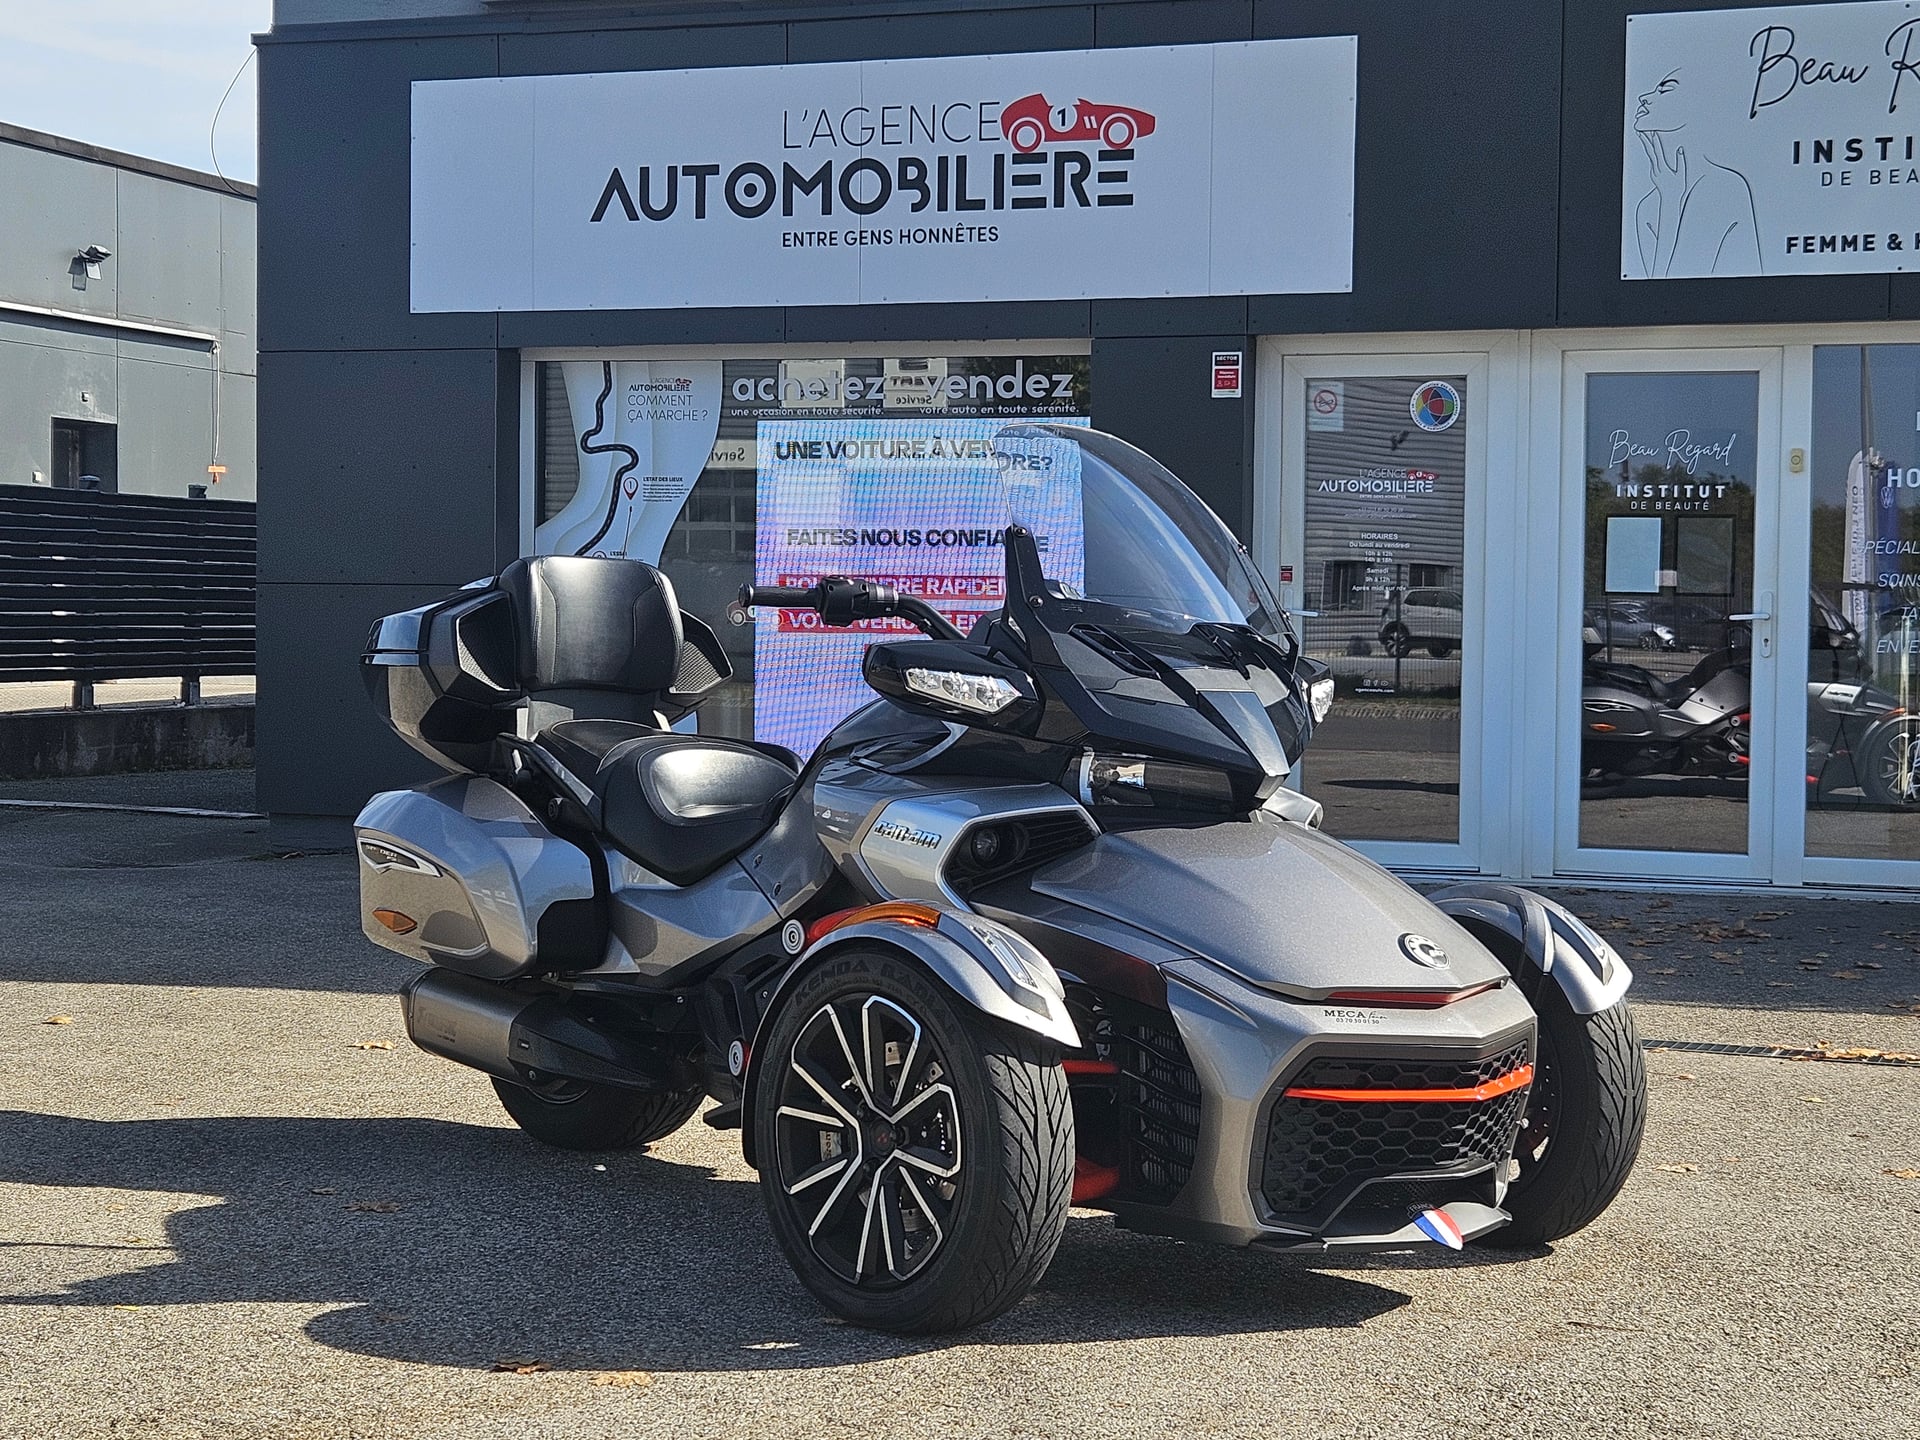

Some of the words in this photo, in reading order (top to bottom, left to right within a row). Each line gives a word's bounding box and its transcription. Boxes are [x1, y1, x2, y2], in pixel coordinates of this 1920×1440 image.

[1749, 25, 1869, 119] Beau
[783, 101, 1000, 149] L'AGENCE
[1792, 136, 1913, 164] INSTI
[1821, 171, 1852, 187] DE
[782, 230, 838, 248] ENTRE
[843, 229, 893, 247] GENS
[899, 222, 999, 245] HONNÊTES
[1786, 233, 1876, 253] FEMME
[1886, 233, 1903, 250] &
[732, 362, 886, 401] achetez
[921, 359, 1074, 399] vendez
[627, 394, 694, 406] COMMENT
[920, 405, 948, 414] votre
[952, 405, 977, 414] auto
[980, 406, 994, 414] en
[998, 404, 1028, 414] toute
[1031, 402, 1080, 414] sérénité.
[627, 409, 644, 423] ÇA
[646, 409, 698, 421] MARCHE
[702, 409, 709, 420] ?
[752, 408, 794, 416] occasion
[812, 407, 838, 416] toute
[776, 440, 822, 460] UNE
[825, 440, 926, 460] VOITURE
[1608, 428, 1659, 469] Beau
[1664, 428, 1737, 475] Regard
[1360, 468, 1407, 479] L'AGENCE
[1616, 484, 1726, 499] INSTITUT
[1630, 501, 1647, 510] DE
[1655, 500, 1710, 511] BEAUTÉ
[787, 528, 858, 546] FAITES
[861, 528, 922, 546] NOUS
[926, 529, 1049, 552] CONFIAE
[1361, 532, 1398, 540] HORAIRES
[926, 577, 1006, 596] RAPIDE
[1324, 1010, 1366, 1018] MECA
